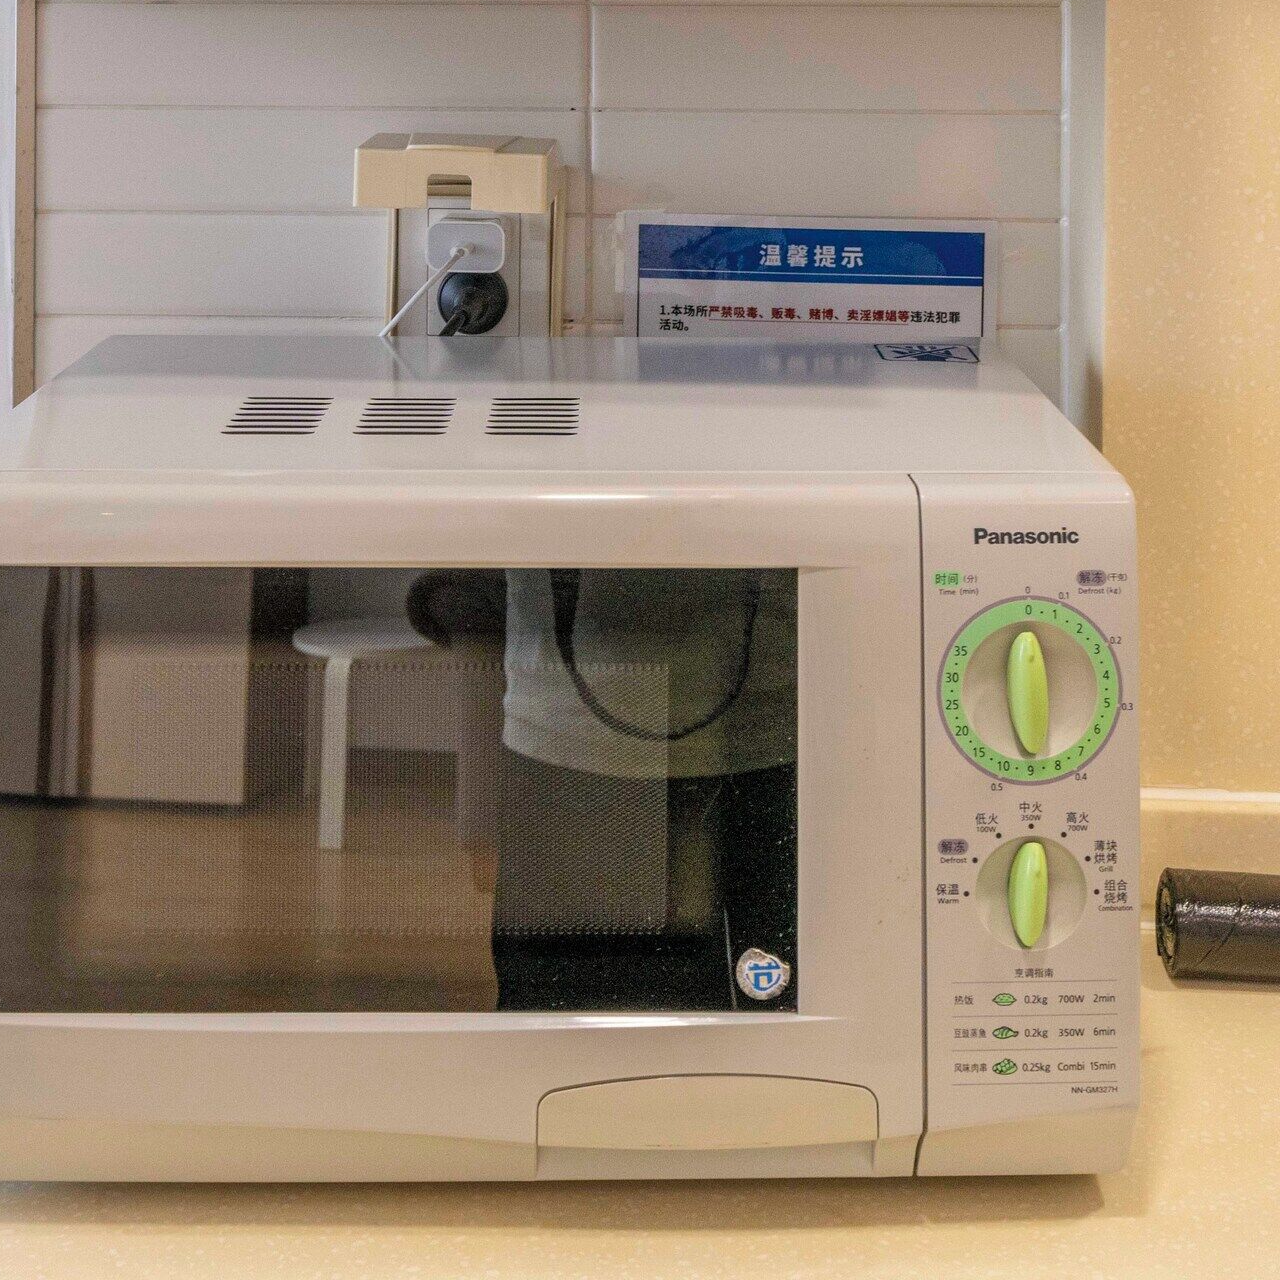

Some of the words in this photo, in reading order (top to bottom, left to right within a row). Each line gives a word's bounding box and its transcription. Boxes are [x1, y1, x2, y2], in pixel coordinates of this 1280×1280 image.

[759, 243, 865, 269] 温馨提示
[973, 527, 1080, 545] Panasonic
[939, 588, 957, 596] Time
[1024, 586, 1031, 594] 0
[1078, 587, 1105, 595] Defrost
[1058, 591, 1070, 600] 0.1
[1025, 604, 1033, 615] 0
[1052, 609, 1058, 619] 1
[1076, 623, 1083, 633] 2
[1109, 636, 1122, 645] 0.2
[954, 645, 968, 656] 35
[1093, 644, 1101, 654] 3
[945, 672, 959, 683] 30
[1102, 670, 1110, 680] 4
[945, 700, 959, 710] 25
[1104, 697, 1111, 708] 5
[1121, 702, 1134, 711] 0.3
[955, 726, 969, 736] 20
[1094, 724, 1101, 734] 6
[973, 747, 986, 757] 15
[1078, 746, 1085, 756] 7
[998, 761, 1010, 771] 10
[1027, 765, 1034, 775] 9
[1054, 760, 1061, 770] 8
[1075, 773, 1087, 781] 0.4
[990, 782, 1003, 791] 0.5
[1019, 801, 1042, 813] 中火
[975, 812, 998, 825] 低火
[1021, 814, 1041, 822] 350W
[1066, 811, 1089, 824] 高火
[1068, 824, 1088, 832] 700W
[940, 856, 967, 864] Defrost
[936, 883, 960, 896] 保温
[1104, 879, 1128, 892] 组合
[1104, 892, 1128, 904] 烧烤
[1098, 904, 1133, 912] Combination
[1023, 994, 1048, 1006] 0.2kg
[1058, 994, 1085, 1003] 700W
[1093, 993, 1116, 1003] 2min
[1024, 1028, 1048, 1039] 0.2kg
[1058, 1028, 1085, 1037] 350W
[1093, 1027, 1116, 1036] 6min
[1021, 1062, 1051, 1073] 0.25kg
[1057, 1061, 1085, 1071] Combi
[1090, 1061, 1117, 1071] 15min
